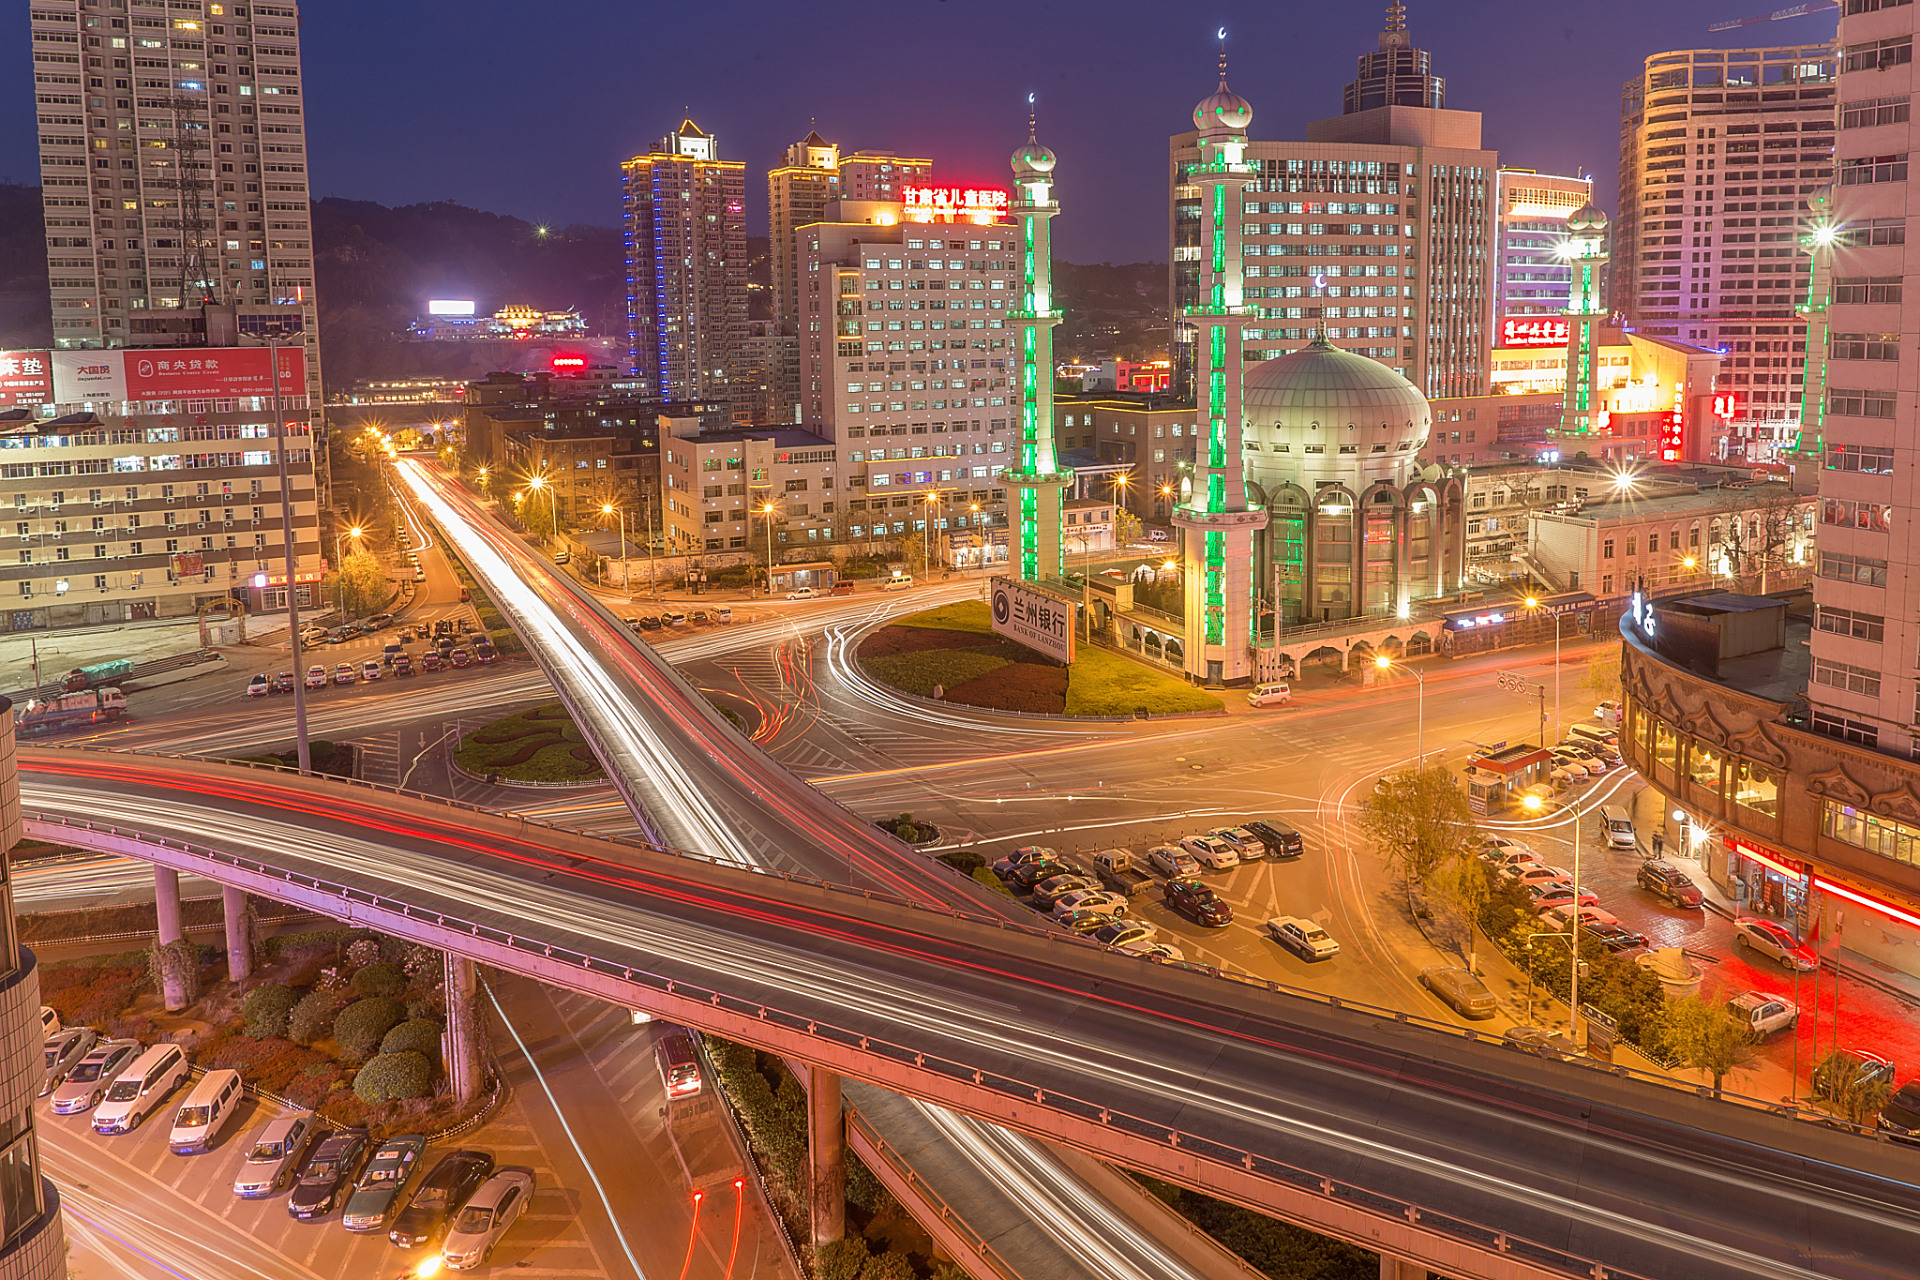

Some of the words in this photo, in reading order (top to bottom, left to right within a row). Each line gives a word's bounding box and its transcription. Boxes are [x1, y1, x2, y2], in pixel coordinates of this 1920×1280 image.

[903, 187, 1007, 207] 甘肃省儿童医院
[156, 359, 219, 371] 商央贷款
[1013, 596, 1066, 638] 兰州银行
[1013, 624, 1028, 636] BANK
[1029, 631, 1037, 640] OF
[1037, 633, 1066, 652] LANZHOU
